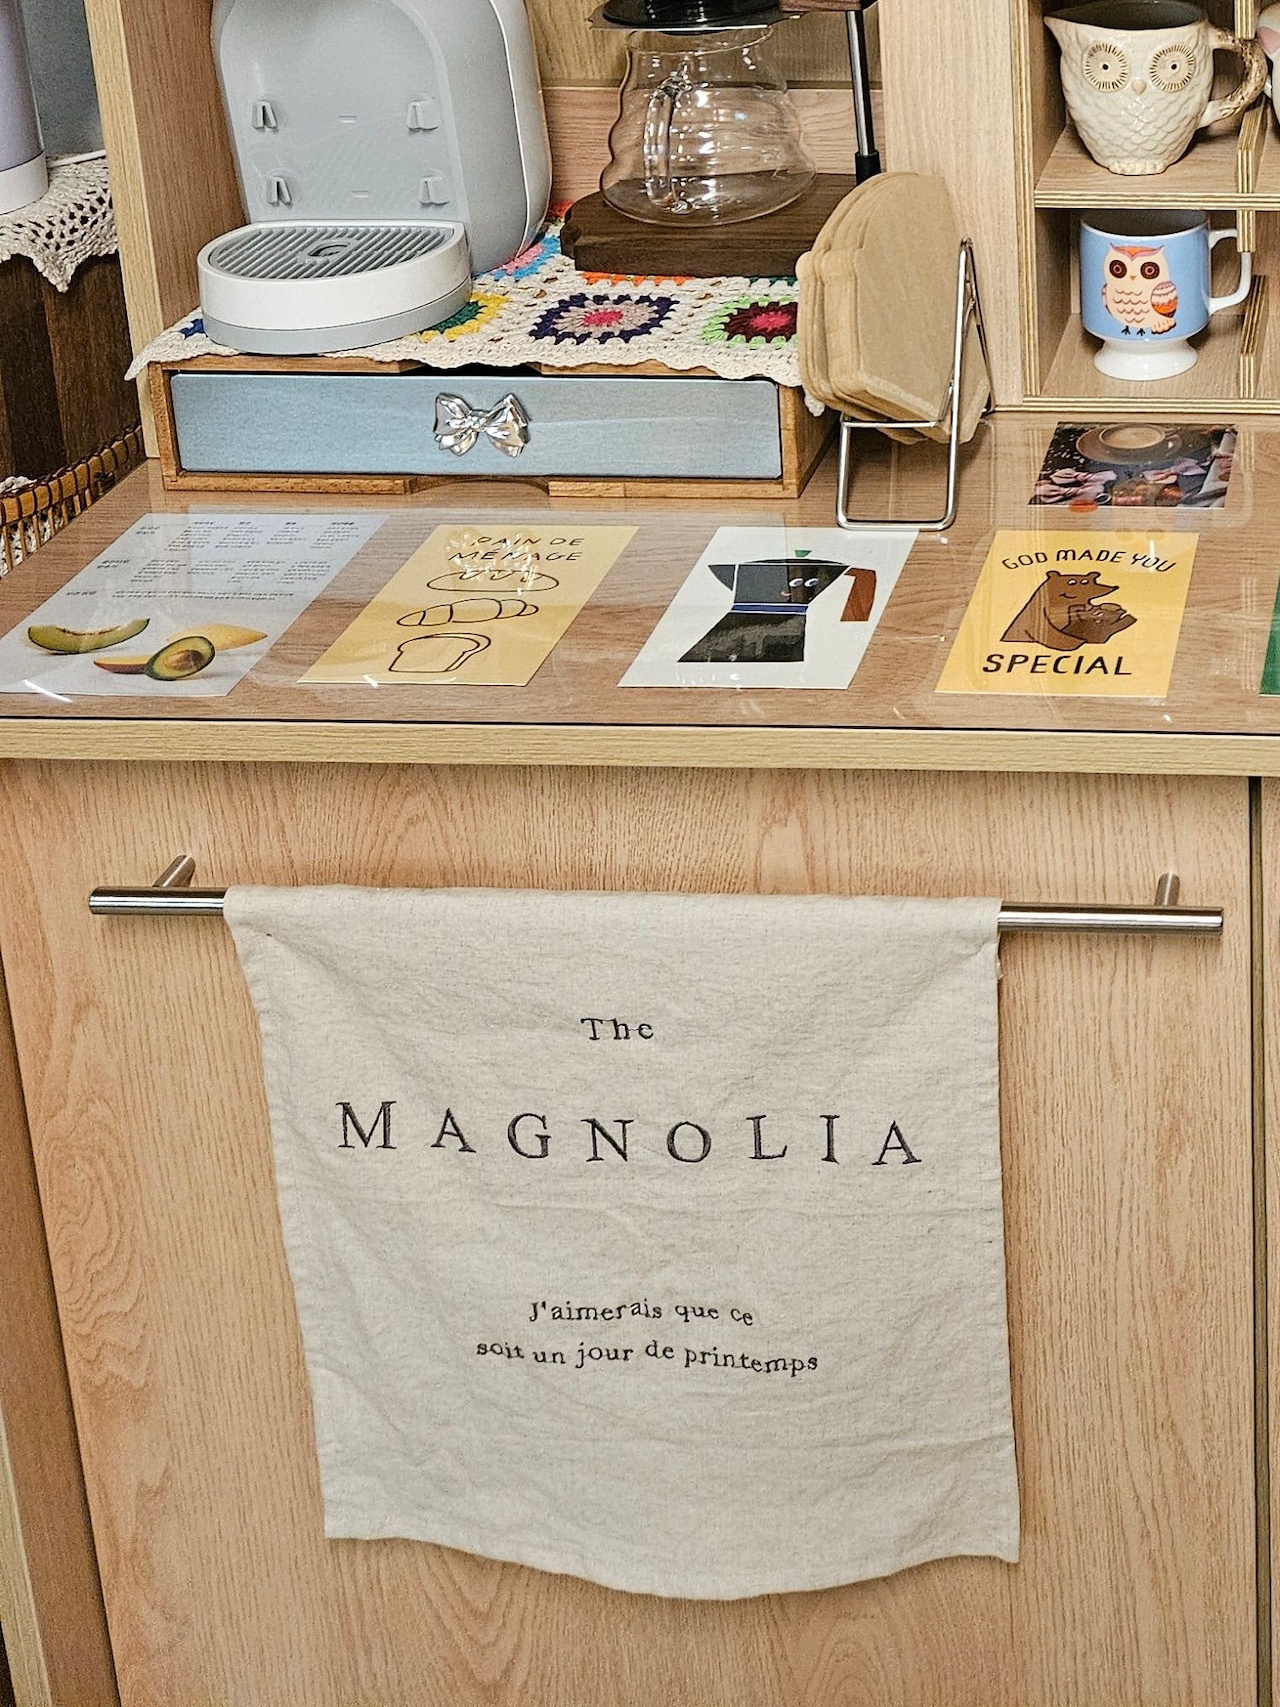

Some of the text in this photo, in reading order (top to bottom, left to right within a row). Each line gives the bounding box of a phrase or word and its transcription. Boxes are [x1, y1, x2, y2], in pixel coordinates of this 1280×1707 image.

[471, 536, 585, 547] PAIN DE
[448, 548, 583, 561] MÉNAGE
[1001, 549, 1177, 573] GOD MADE YOU
[982, 653, 1133, 676] SPECIAL
[581, 1016, 655, 1042] The
[335, 1099, 923, 1167] MAGNOLIA
[529, 1297, 754, 1326] J'aimerais que ce
[476, 1339, 819, 1377] soit un jour de printemps
